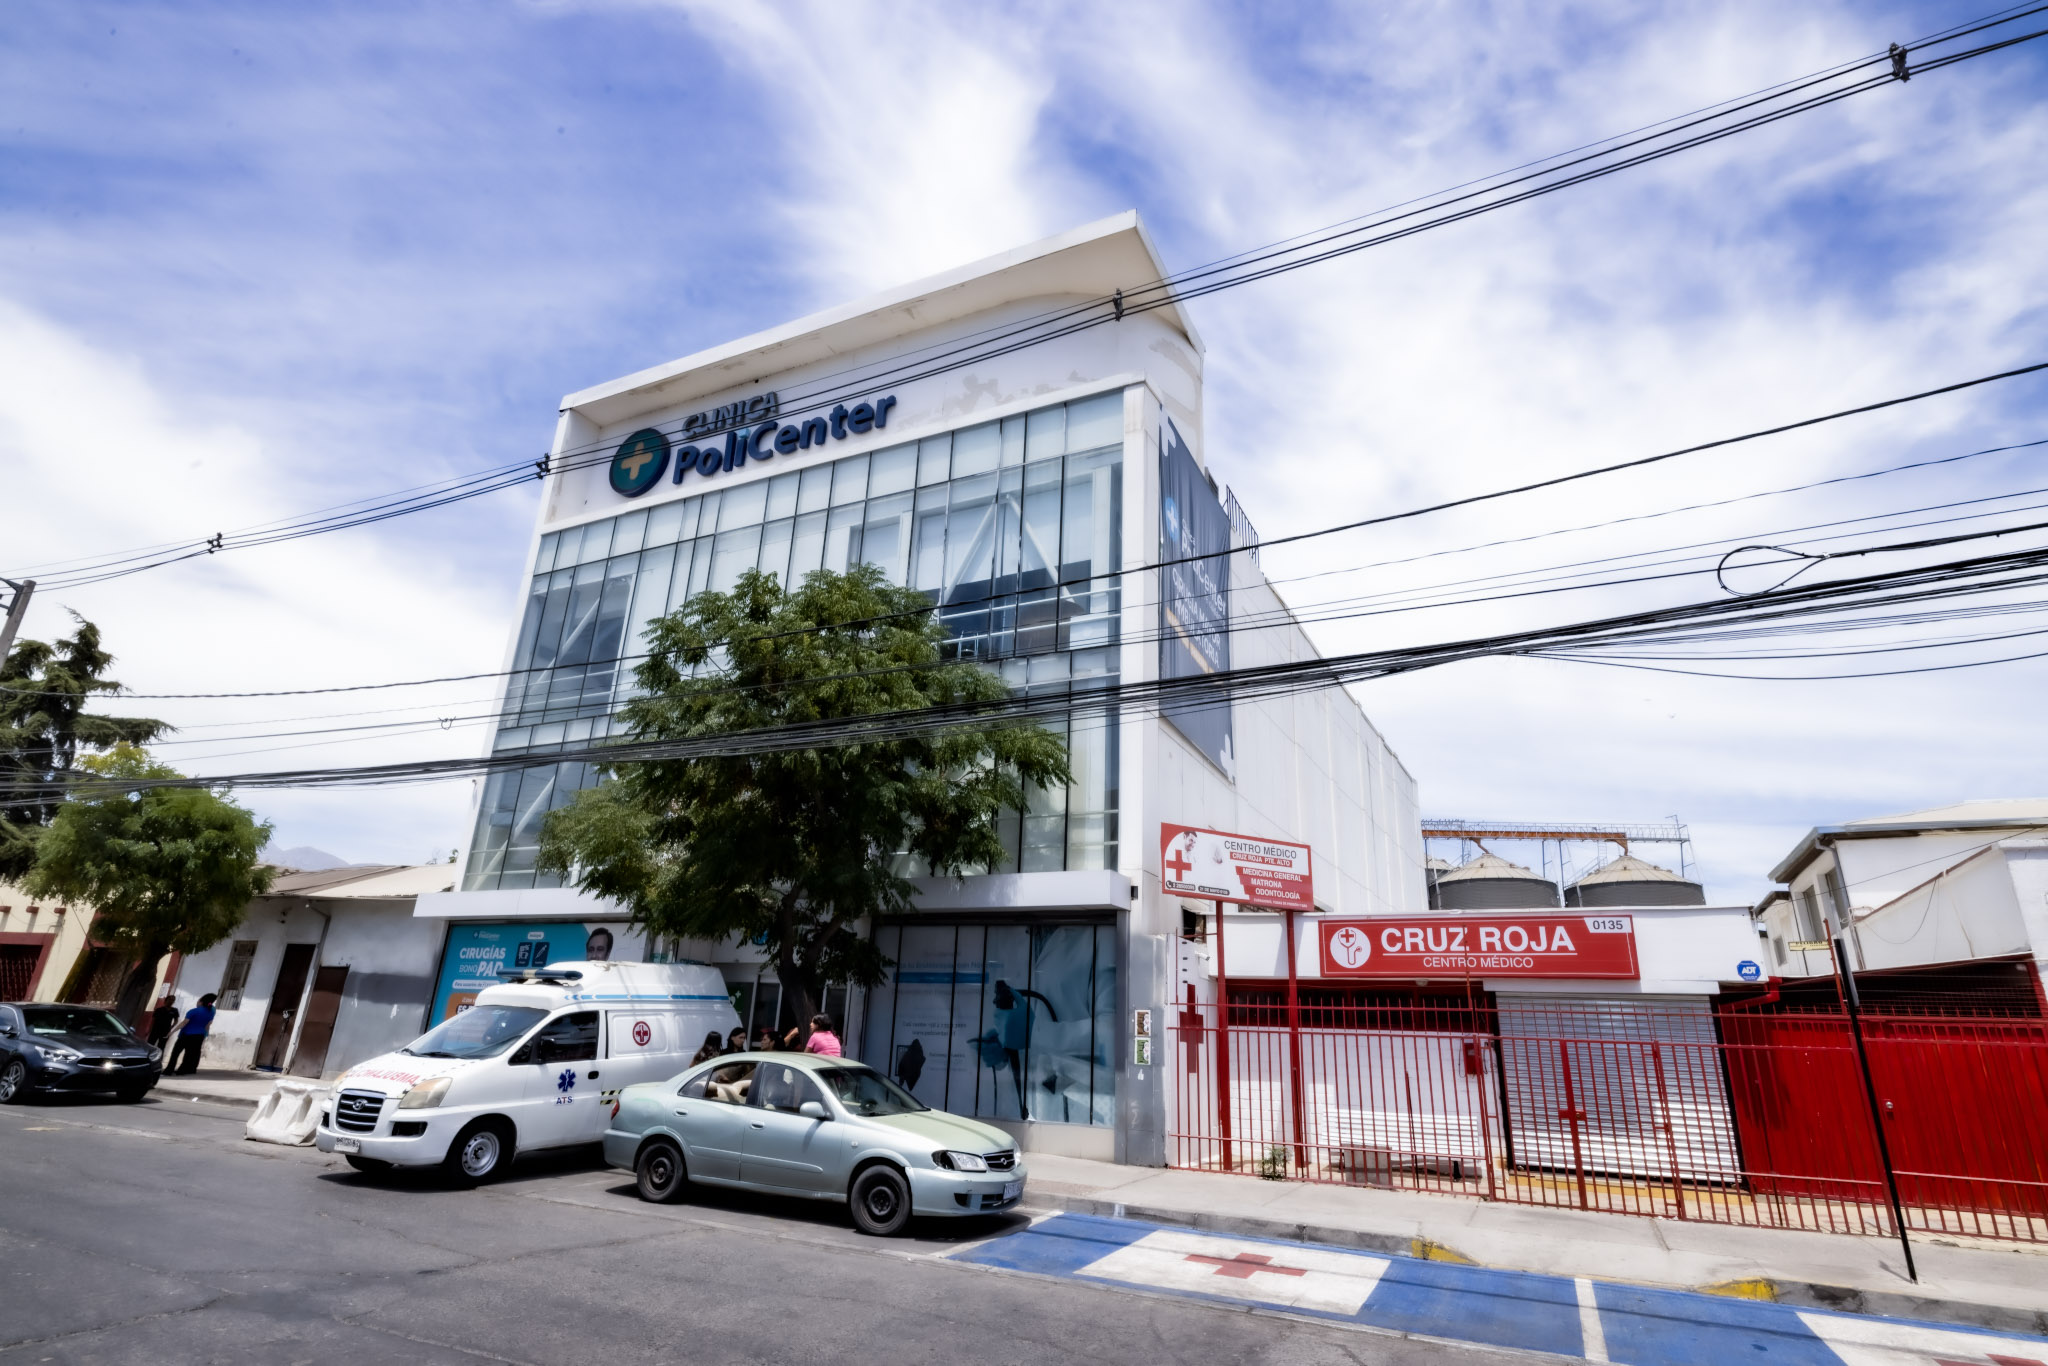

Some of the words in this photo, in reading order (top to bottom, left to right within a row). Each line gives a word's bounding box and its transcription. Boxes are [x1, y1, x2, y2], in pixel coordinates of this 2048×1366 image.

[681, 391, 780, 440] CLINICA
[671, 395, 896, 485] PoliCenter
[1181, 530, 1226, 615] PoliCenter
[1224, 840, 1261, 854] CENTRO
[1263, 845, 1297, 859] MÉDICO
[1232, 852, 1247, 860] CRUZ
[1248, 854, 1263, 863] ROJA
[1242, 867, 1272, 878] MEDICINA
[1273, 871, 1303, 882] GENERAL
[1250, 878, 1282, 888] MATRONA
[1255, 887, 1300, 900] ODONTOLOGÍA
[1592, 919, 1625, 931] 0135
[1381, 926, 1468, 953] CRUZ
[1480, 925, 1576, 952] ROJA
[459, 944, 506, 959] CIRUGÍAS
[459, 964, 478, 973] BONO
[1423, 956, 1477, 969] CENTRO
[1480, 953, 1534, 968] MÉDICO
[1742, 966, 1757, 975] ADT
[556, 1096, 573, 1105] ATS
